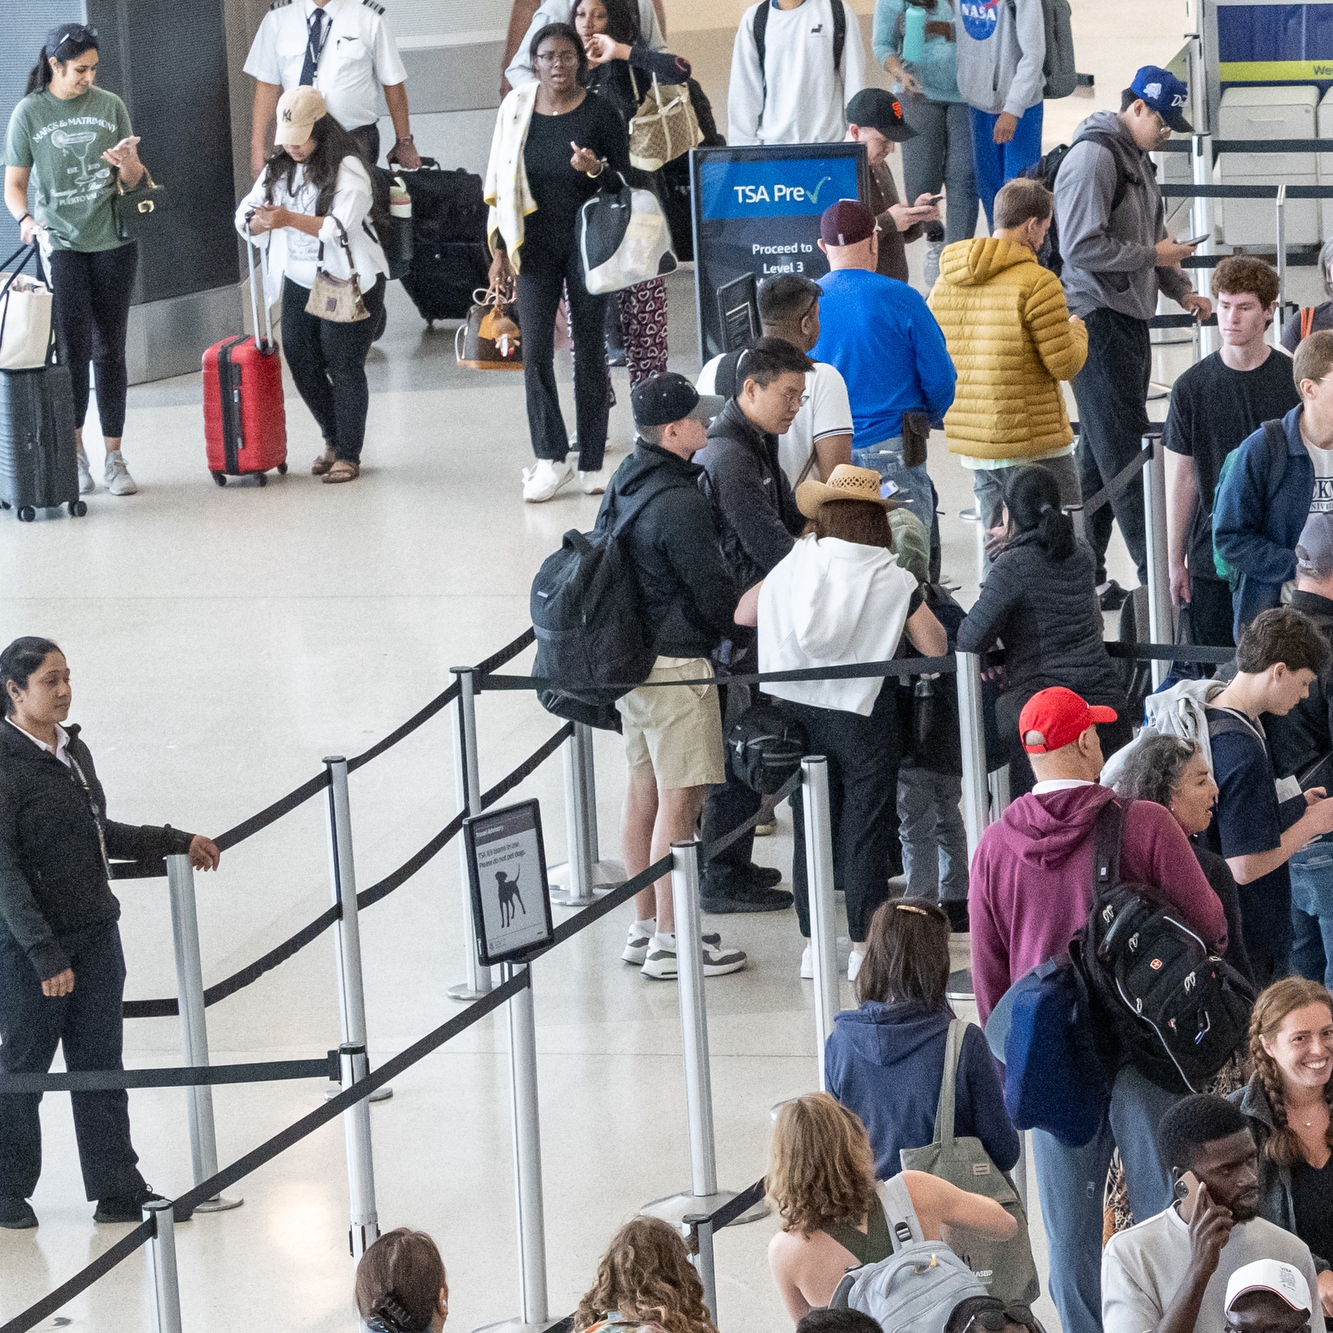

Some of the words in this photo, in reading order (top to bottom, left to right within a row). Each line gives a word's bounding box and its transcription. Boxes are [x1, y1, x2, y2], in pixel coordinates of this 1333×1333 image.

[961, 4, 996, 21] NASA
[67, 116, 117, 133] MATRIMONY
[733, 185, 770, 203] TSA
[773, 184, 805, 202] Pre
[752, 243, 798, 255] Proceed
[801, 243, 813, 253] to
[763, 262, 794, 274] Level
[796, 261, 804, 273] 3
